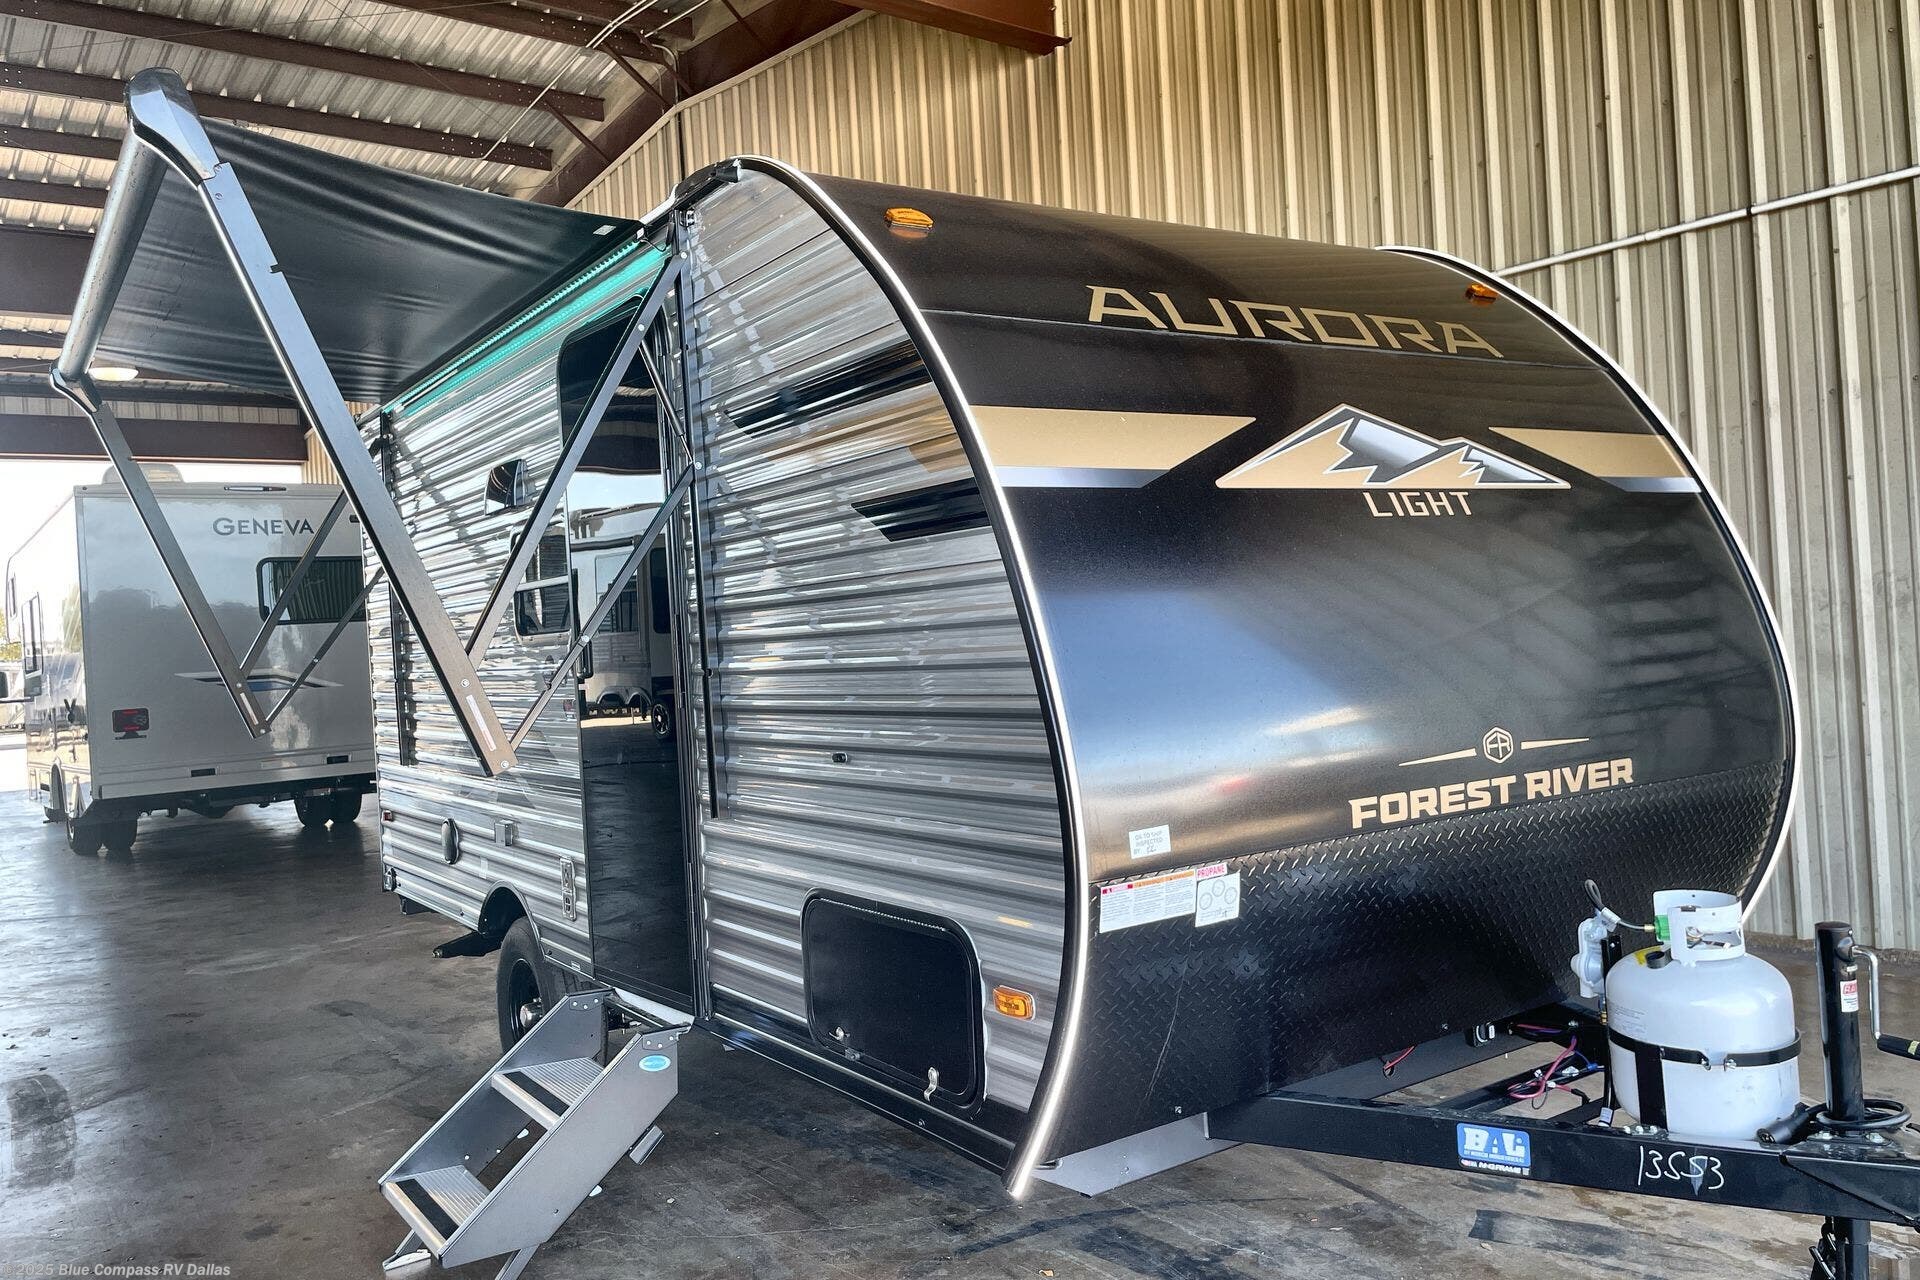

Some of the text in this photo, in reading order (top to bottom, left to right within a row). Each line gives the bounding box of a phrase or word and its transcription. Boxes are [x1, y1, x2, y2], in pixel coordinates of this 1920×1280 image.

[1086, 285, 1504, 358] AURORA
[1363, 492, 1473, 517] LIGHT
[212, 516, 315, 537] GENEVA
[1348, 757, 1634, 829] FOREST RIVER
[1197, 867, 1225, 878] PROPANE
[1464, 1127, 1526, 1157] BAL
